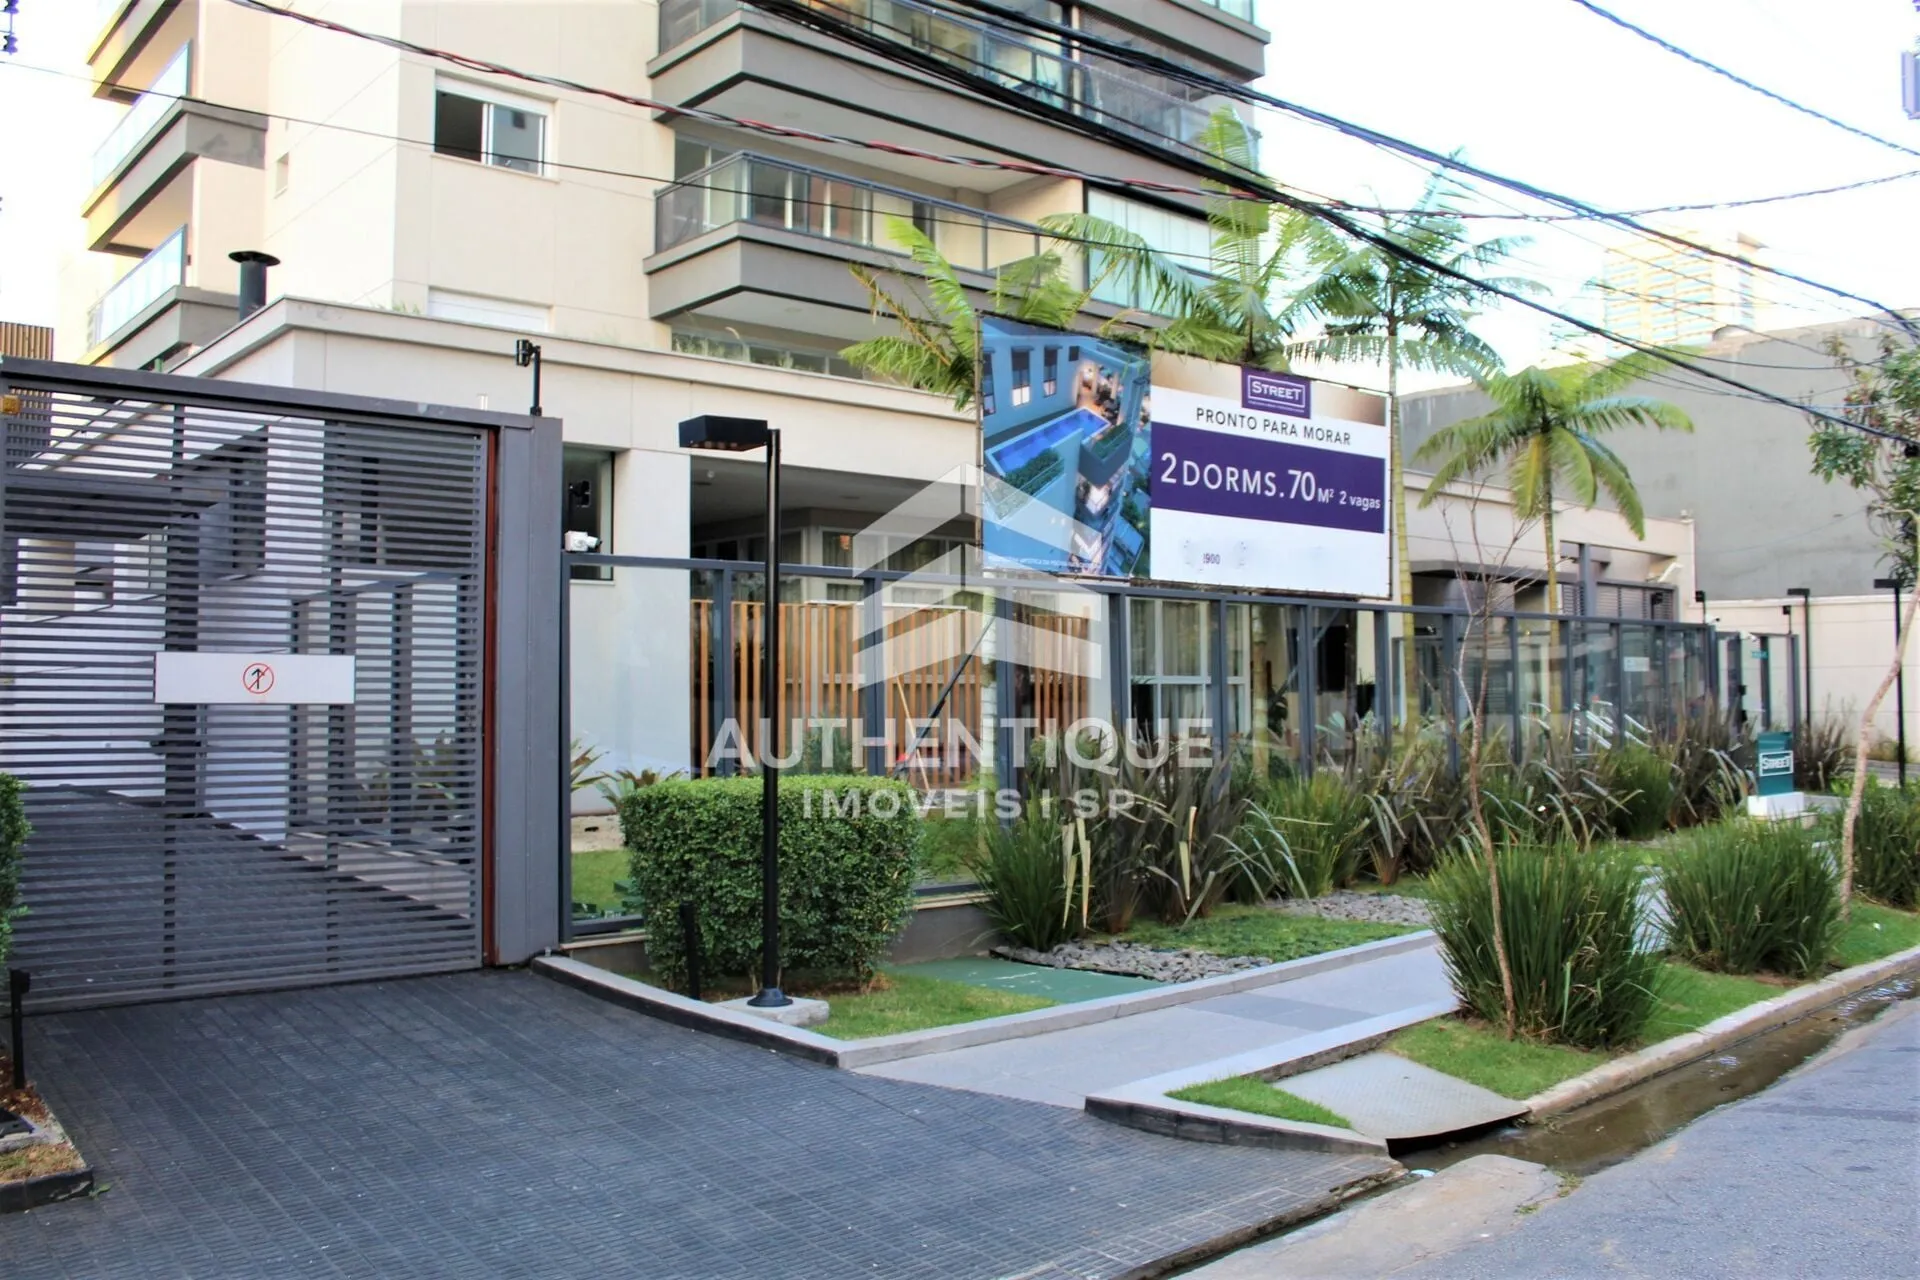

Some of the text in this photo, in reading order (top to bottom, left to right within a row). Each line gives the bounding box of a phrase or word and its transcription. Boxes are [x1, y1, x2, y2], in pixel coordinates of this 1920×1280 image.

[1251, 381, 1302, 400] STREET
[1196, 407, 1258, 431] PRONTO
[1263, 418, 1298, 438] PARA
[1303, 425, 1351, 446] MORAR
[1160, 452, 1177, 484] 2
[1339, 491, 1347, 505] 2
[1350, 494, 1381, 512] vagas
